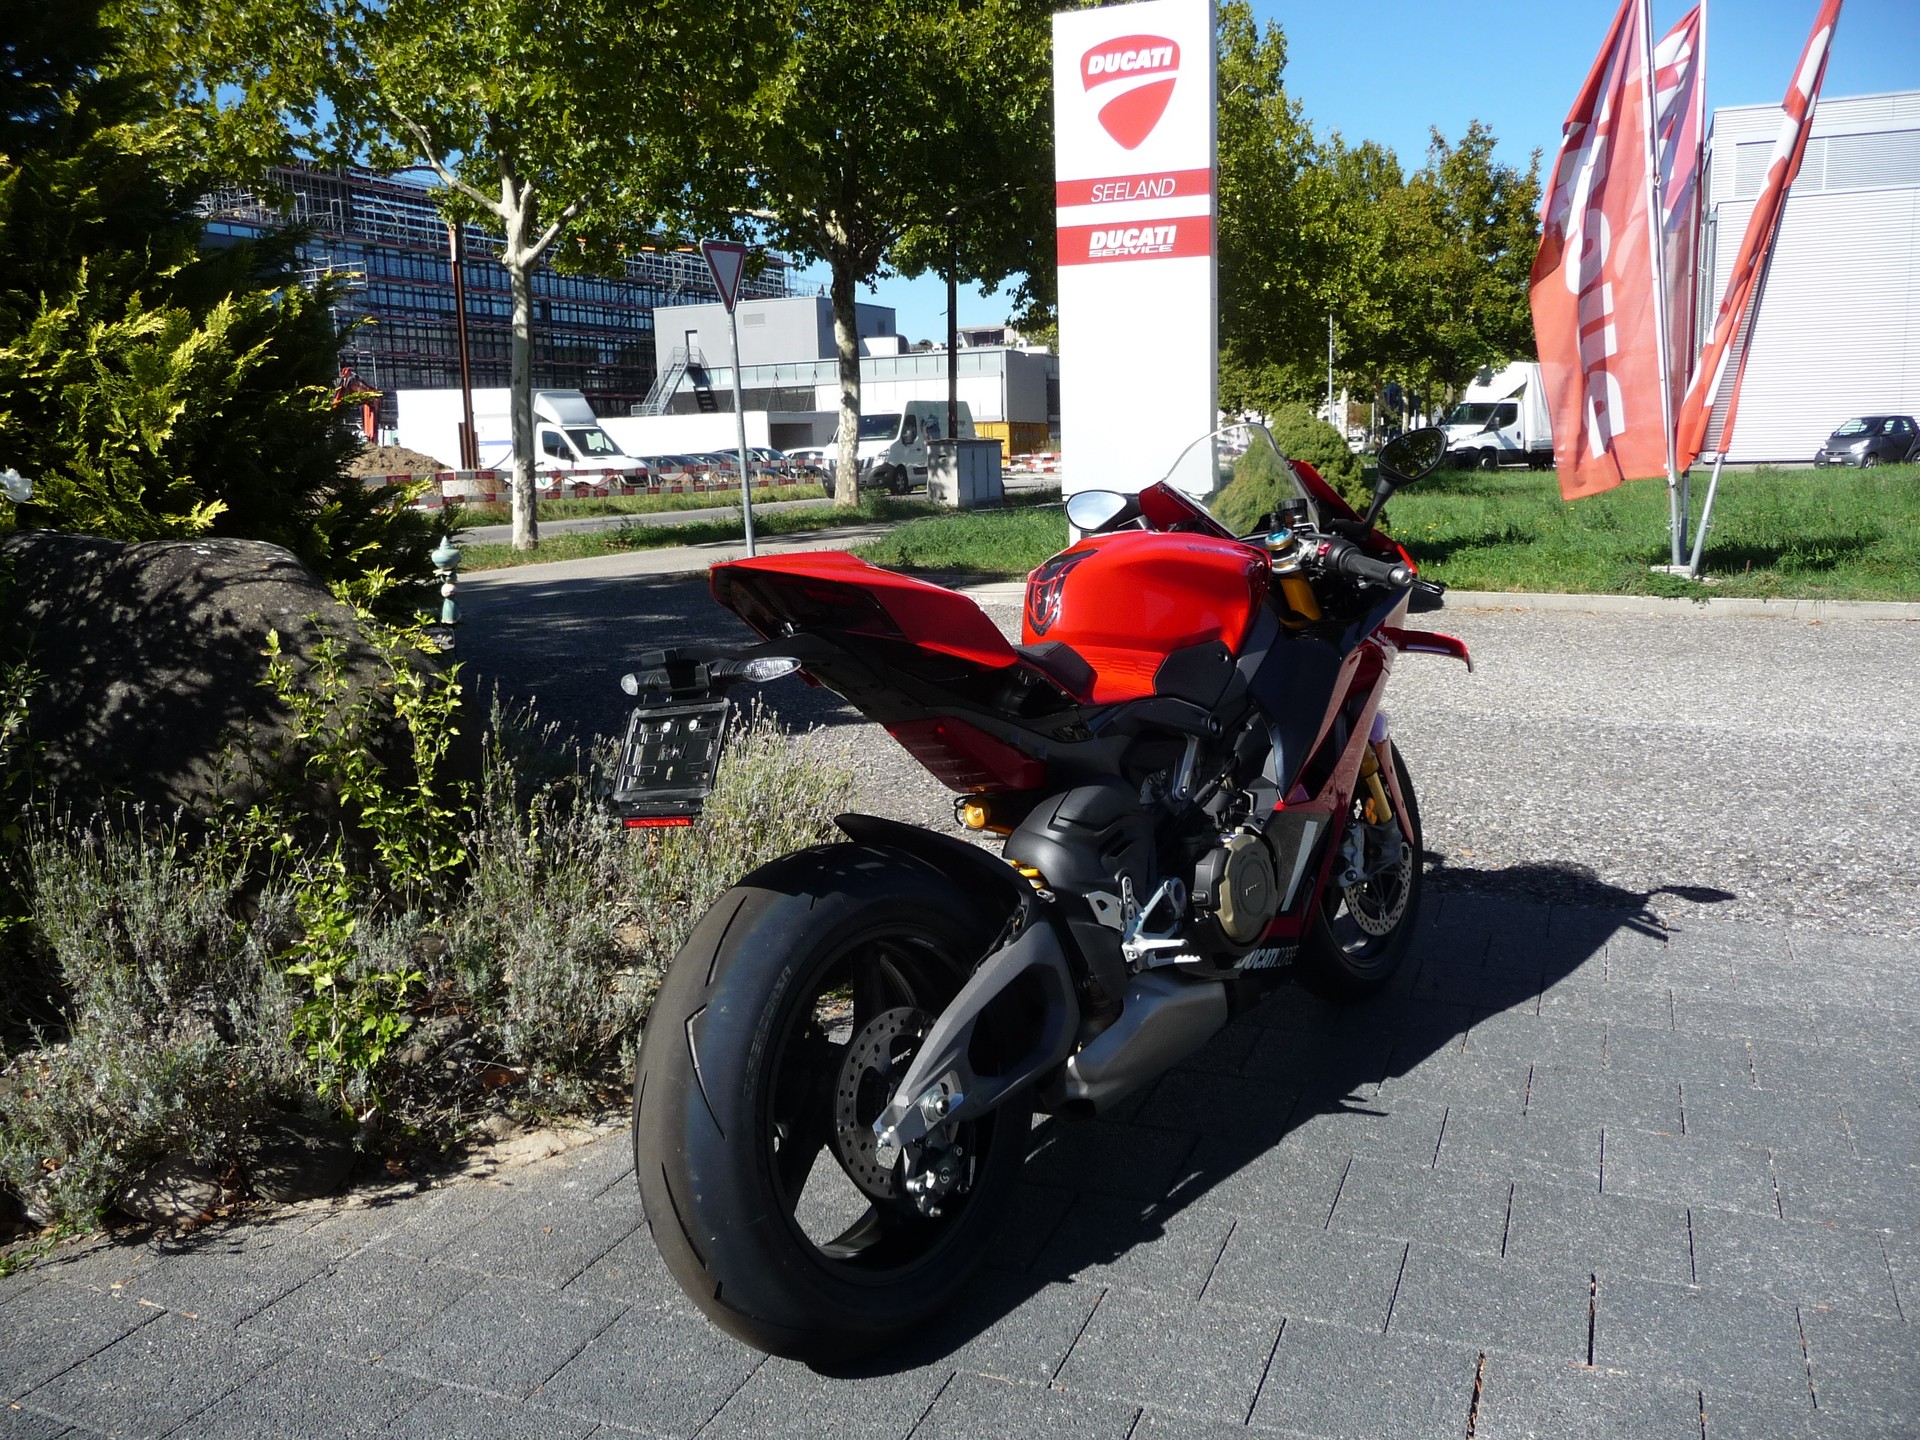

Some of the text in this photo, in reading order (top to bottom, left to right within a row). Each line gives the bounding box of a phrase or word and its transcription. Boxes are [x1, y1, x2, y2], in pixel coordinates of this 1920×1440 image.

[1087, 46, 1173, 75] DUCATI
[1090, 178, 1175, 203] SEELAND
[1089, 225, 1177, 250] DUCATI
[1088, 244, 1173, 258] SERVICE
